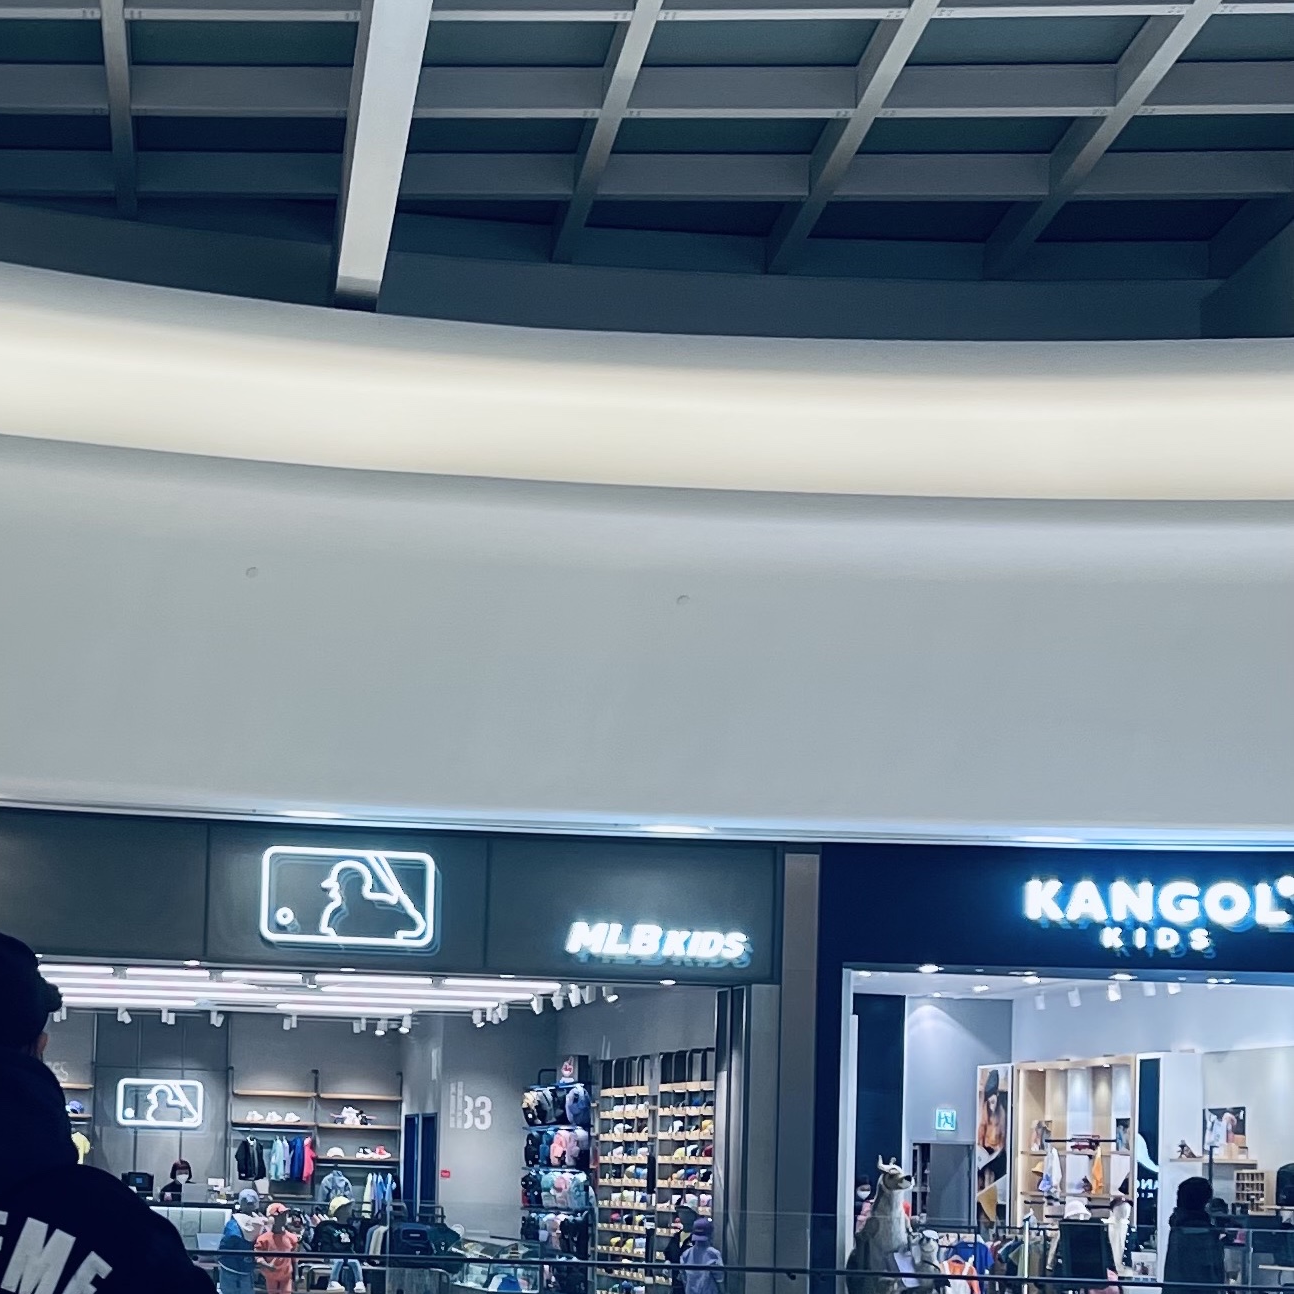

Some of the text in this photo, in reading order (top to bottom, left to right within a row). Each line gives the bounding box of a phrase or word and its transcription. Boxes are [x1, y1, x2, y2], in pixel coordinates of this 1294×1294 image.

[1023, 878, 1292, 926] KANGOL
[565, 921, 749, 959] MLB KIDS
[1100, 926, 1211, 950] KIDS
